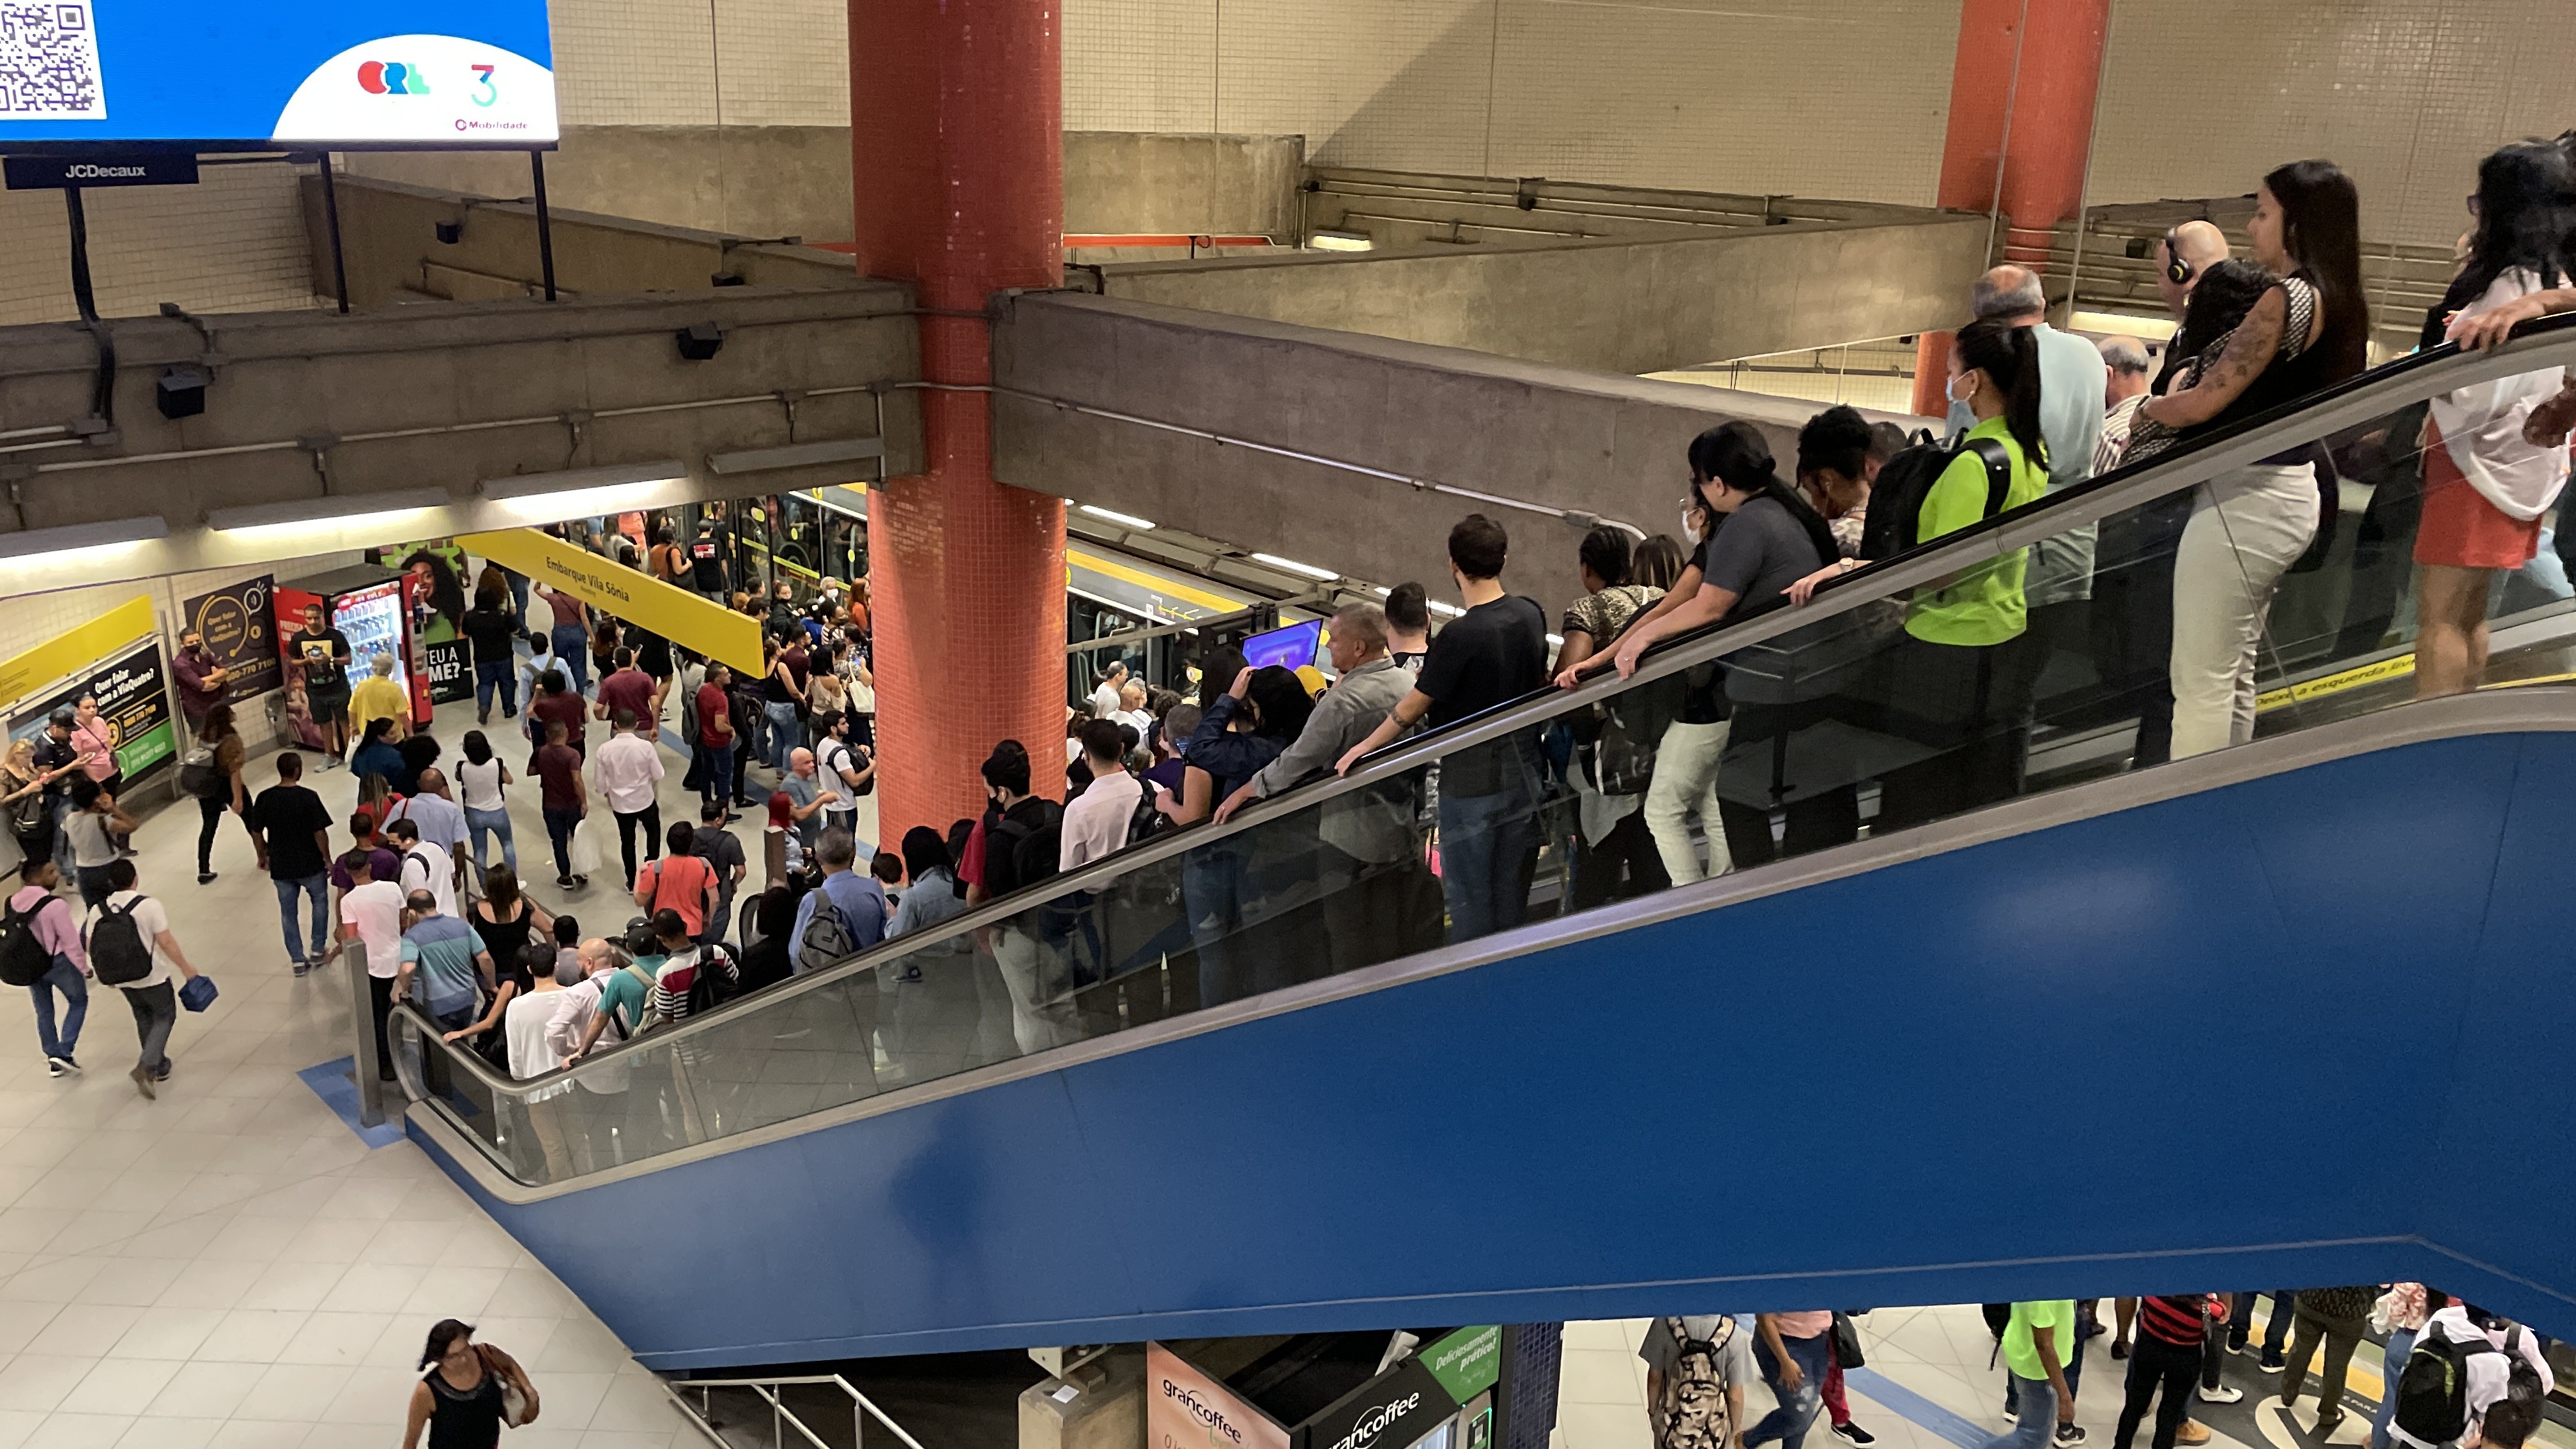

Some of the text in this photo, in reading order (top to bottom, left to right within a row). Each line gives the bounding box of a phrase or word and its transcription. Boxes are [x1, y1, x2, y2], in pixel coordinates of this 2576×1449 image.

[470, 121, 528, 129] Mobilidade
[65, 165, 146, 178] JCDecaux
[546, 556, 586, 583] Embarque
[587, 573, 604, 591] Vila
[606, 581, 630, 602] Sônia
[426, 647, 458, 664] EU A
[95, 670, 129, 694] Quer falar
[2312, 666, 2386, 689] esquerda
[97, 692, 112, 707] com
[112, 689, 118, 698] a
[1436, 1326, 1498, 1371] Deliciosamente
[1460, 1337, 1497, 1372] prático!
[1163, 1379, 1241, 1444] grancoffee
[1328, 1392, 1420, 1449] ancoffee
